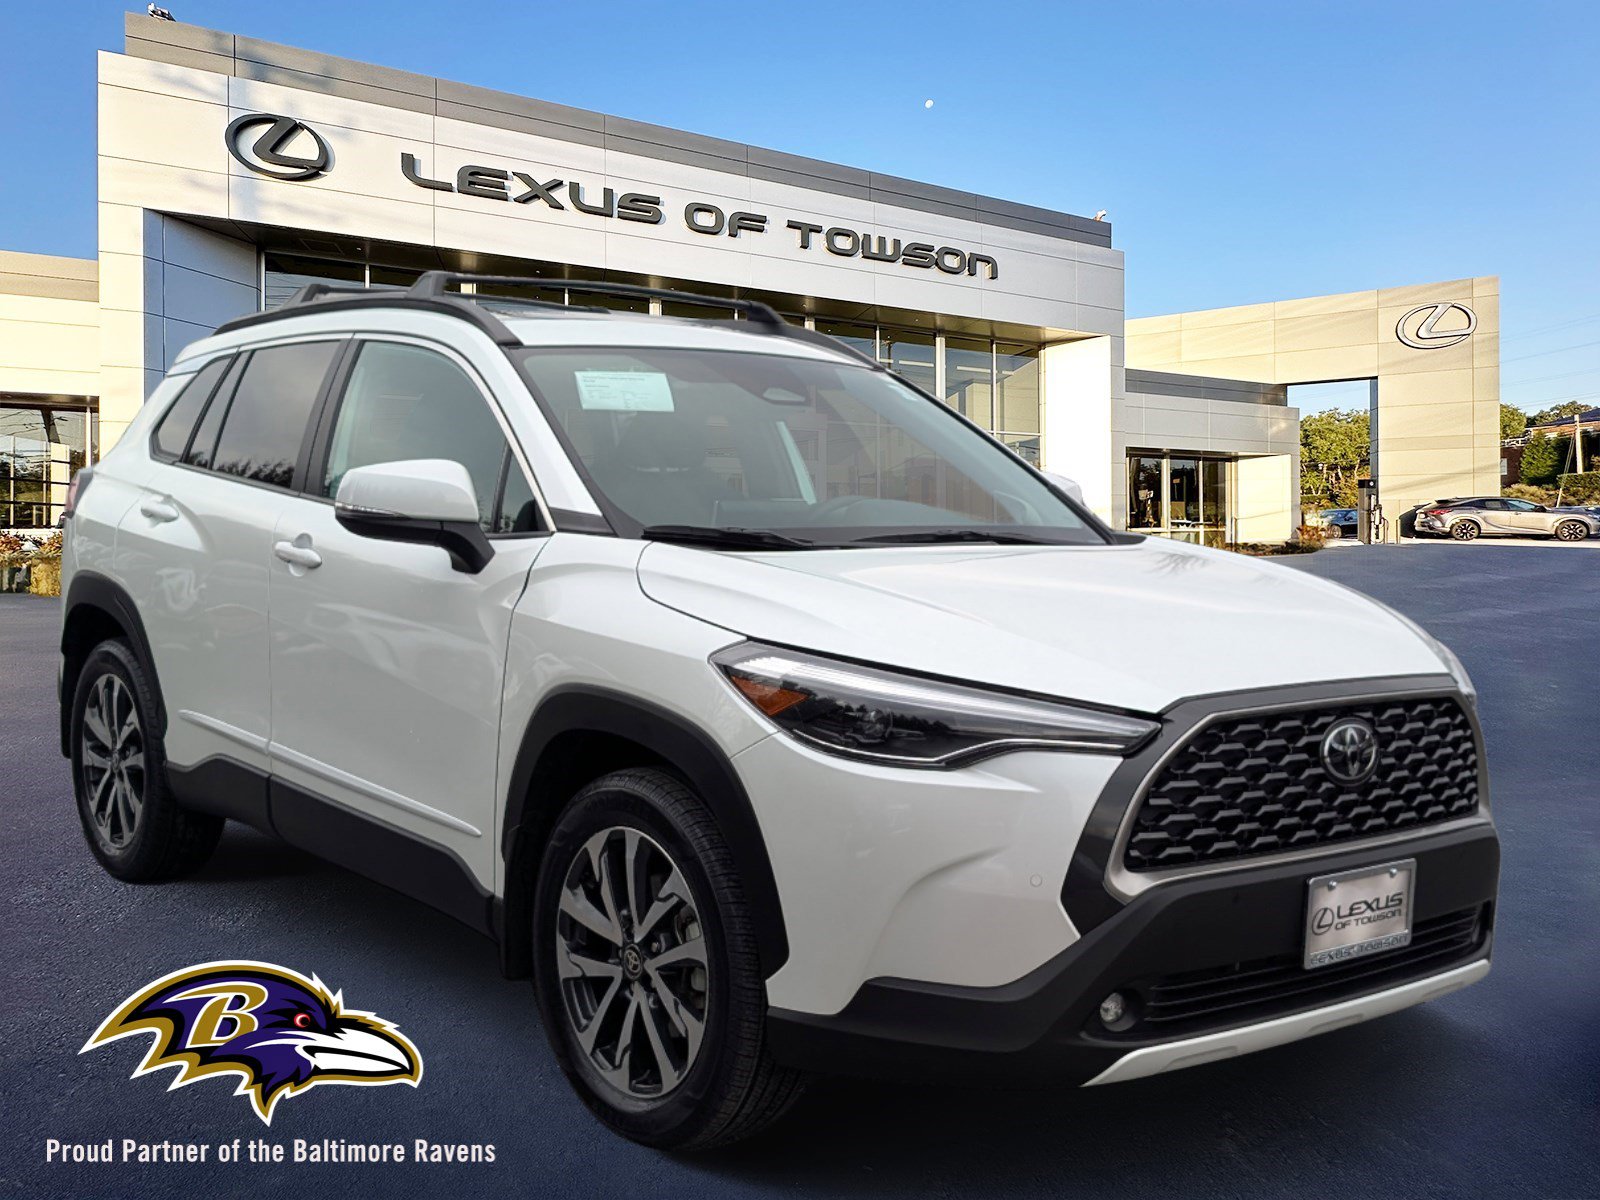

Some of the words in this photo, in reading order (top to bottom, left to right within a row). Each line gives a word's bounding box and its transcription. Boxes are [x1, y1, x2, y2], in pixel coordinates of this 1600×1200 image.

[400, 152, 663, 225] LEXUS
[684, 201, 768, 237] OF
[786, 218, 999, 280] TOWSON
[1337, 892, 1403, 919] LEXUS
[1335, 922, 1351, 930] OF
[1355, 909, 1402, 926] TOWSON
